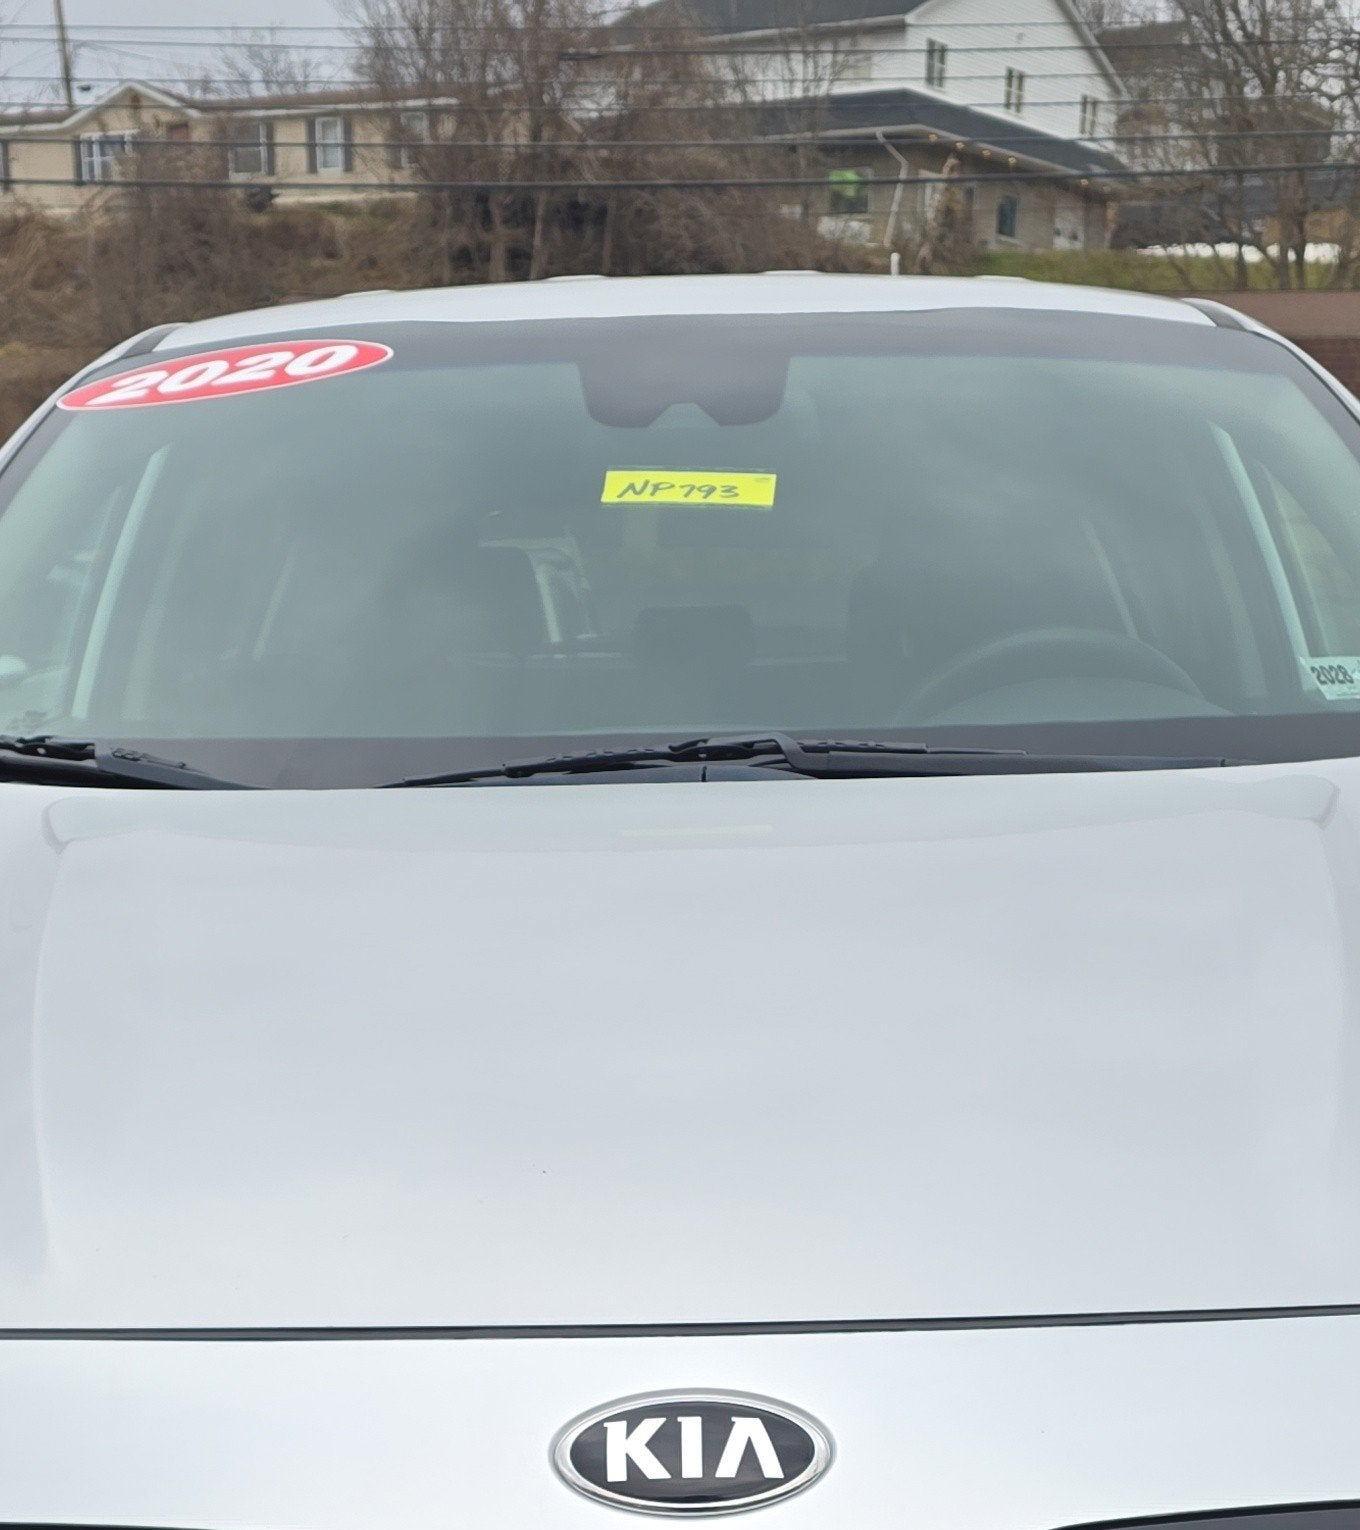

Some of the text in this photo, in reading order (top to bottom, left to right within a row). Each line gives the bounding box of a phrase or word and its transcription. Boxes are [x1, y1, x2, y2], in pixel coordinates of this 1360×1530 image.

[85, 345, 358, 405] 2020
[1310, 664, 1354, 685] 2028
[603, 1416, 785, 1482] KIA
